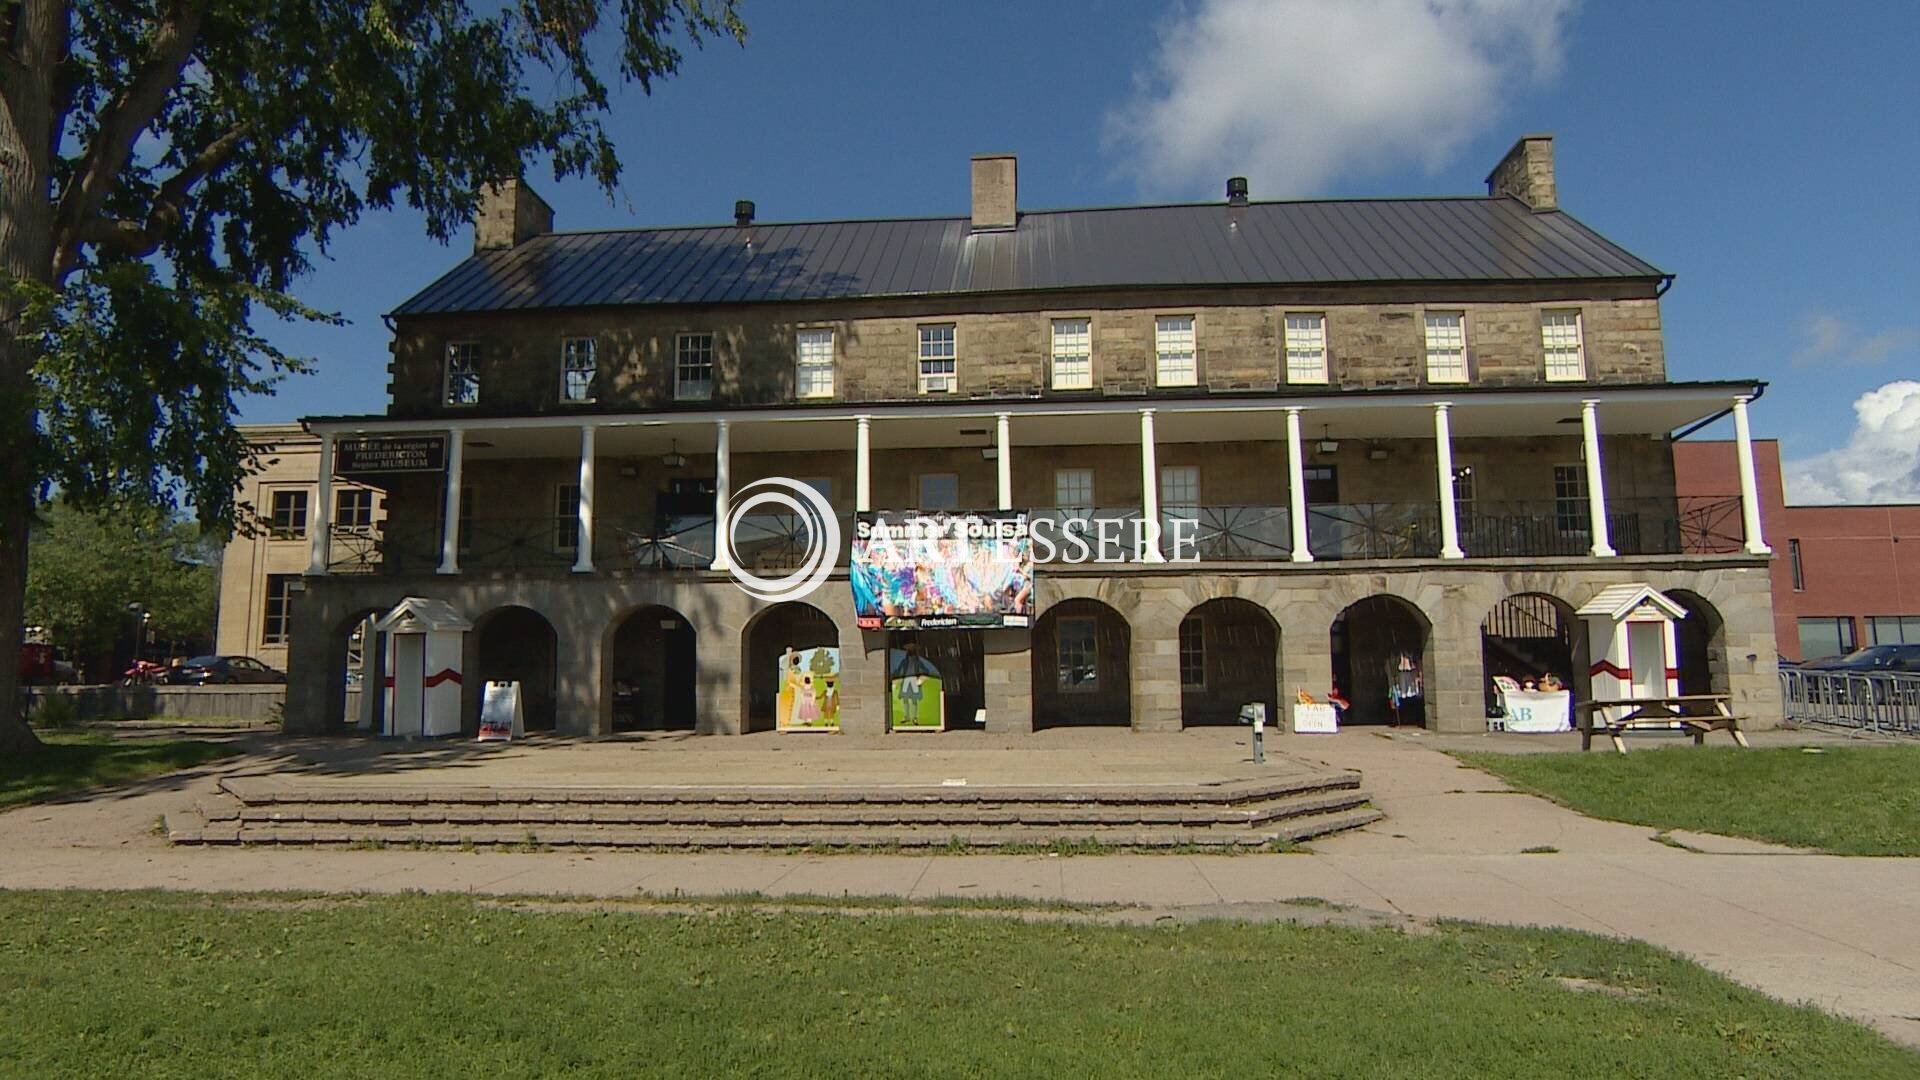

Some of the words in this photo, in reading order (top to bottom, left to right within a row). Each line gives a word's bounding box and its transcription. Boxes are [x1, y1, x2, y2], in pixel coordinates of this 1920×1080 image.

[354, 450, 427, 460] FREDERICTON
[380, 459, 428, 468] MUSEUM
[857, 521, 945, 538] Summer
[920, 617, 957, 628] Fredericton
